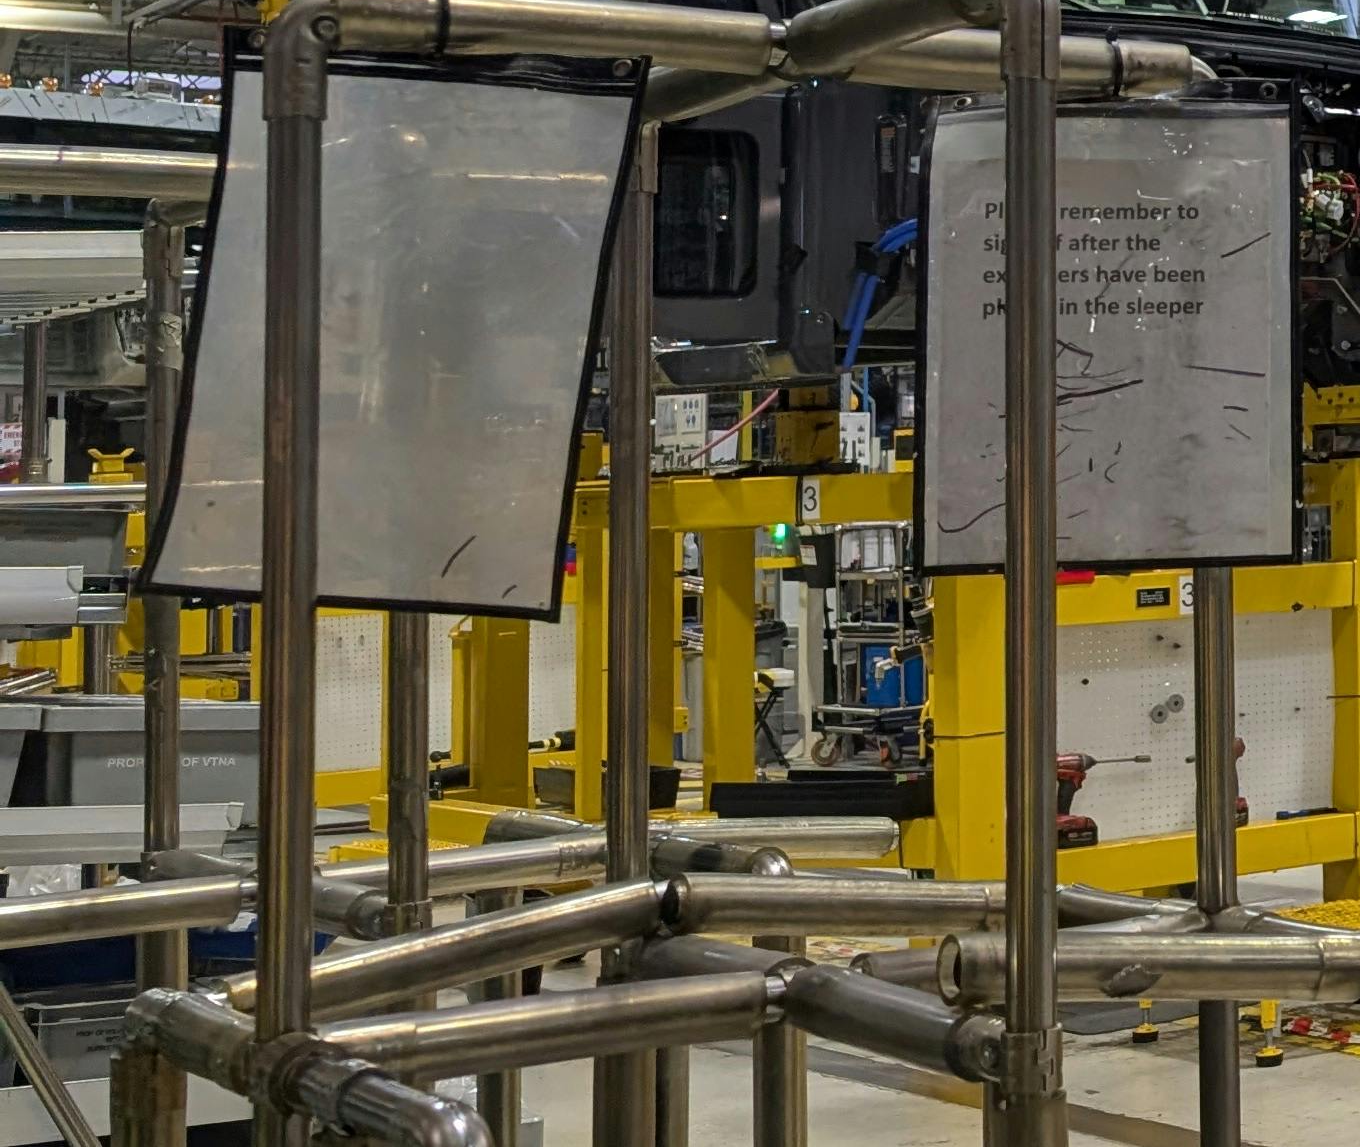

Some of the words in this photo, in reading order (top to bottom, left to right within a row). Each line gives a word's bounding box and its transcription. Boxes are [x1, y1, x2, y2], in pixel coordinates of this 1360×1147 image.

[1059, 202, 1172, 220] remember
[1177, 204, 1200, 220] to
[1068, 234, 1121, 251] after
[1121, 234, 1161, 251] the
[1096, 265, 1147, 284] have
[1154, 265, 1206, 283] been
[1059, 298, 1078, 315] in
[1085, 297, 1121, 315] the
[1126, 297, 1204, 318] sleeper
[803, 485, 817, 512] 3
[1181, 582, 1194, 607] 3
[182, 756, 200, 767] OF
[202, 756, 236, 767] VTNA
